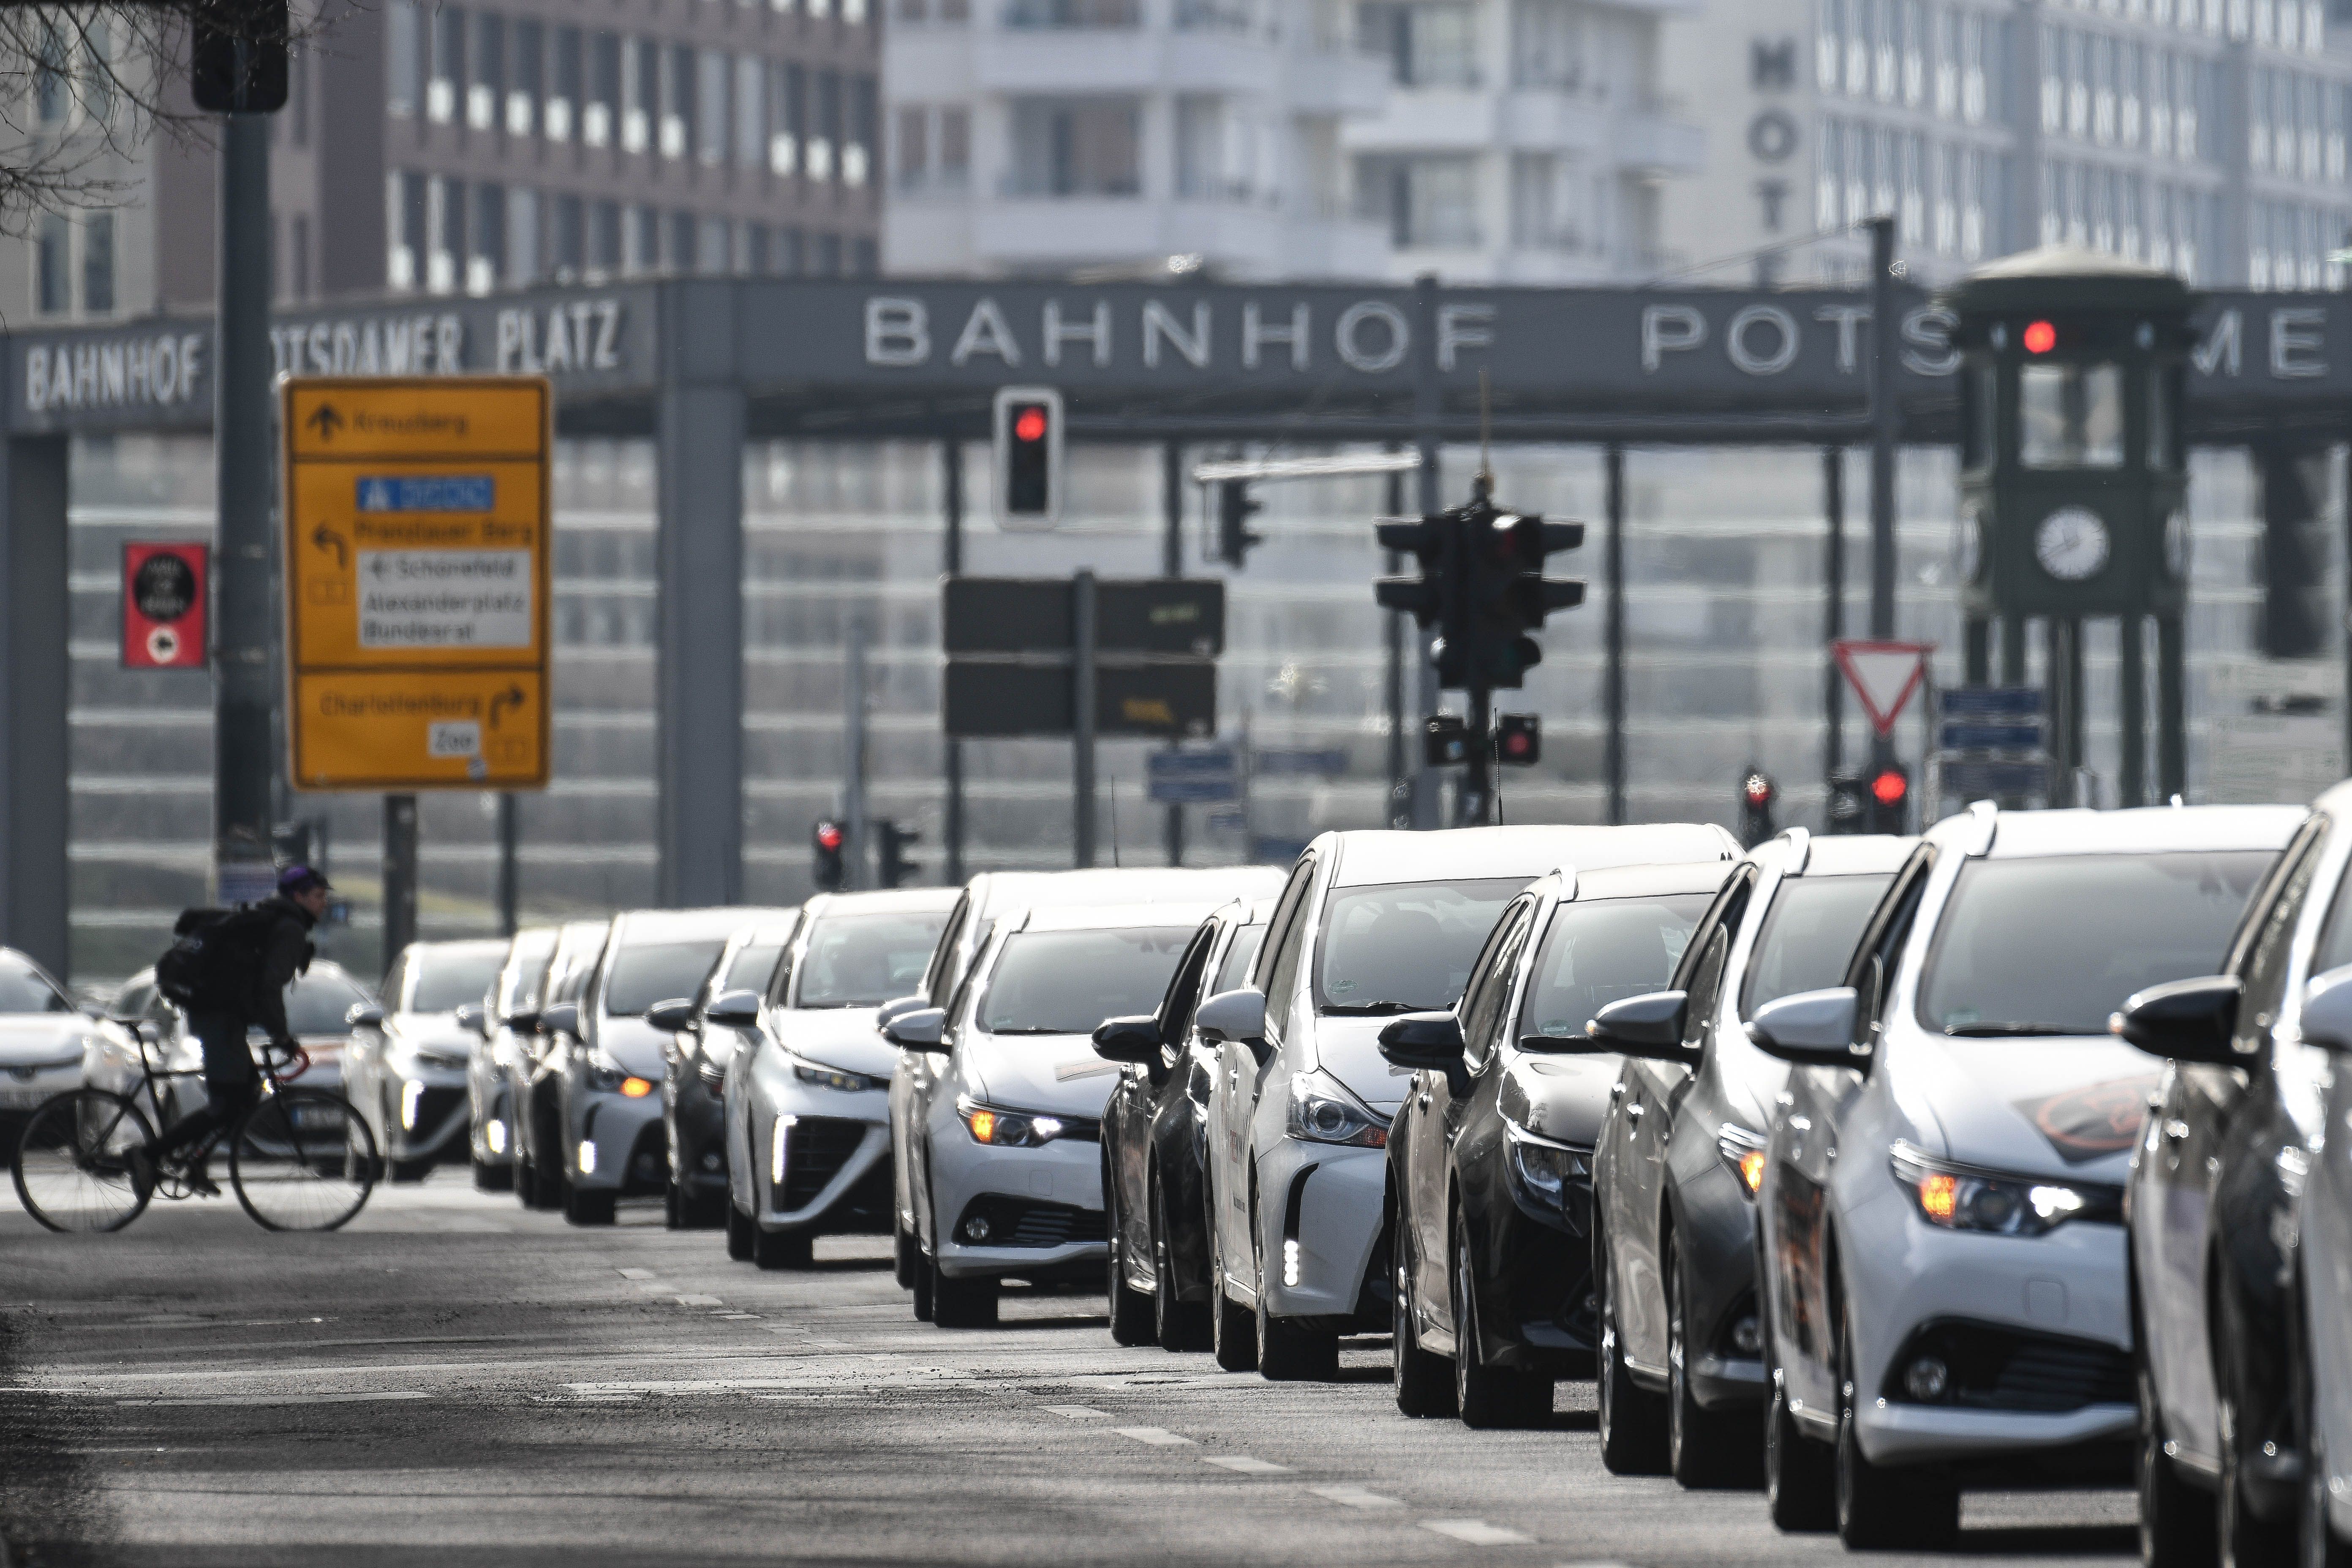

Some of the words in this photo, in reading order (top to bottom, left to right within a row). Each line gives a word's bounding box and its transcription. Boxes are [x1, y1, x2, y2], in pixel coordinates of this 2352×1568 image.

[25, 334, 204, 412] BAHNHOF
[497, 298, 620, 374] PLATZ
[864, 297, 1497, 372] BAHNHOF
